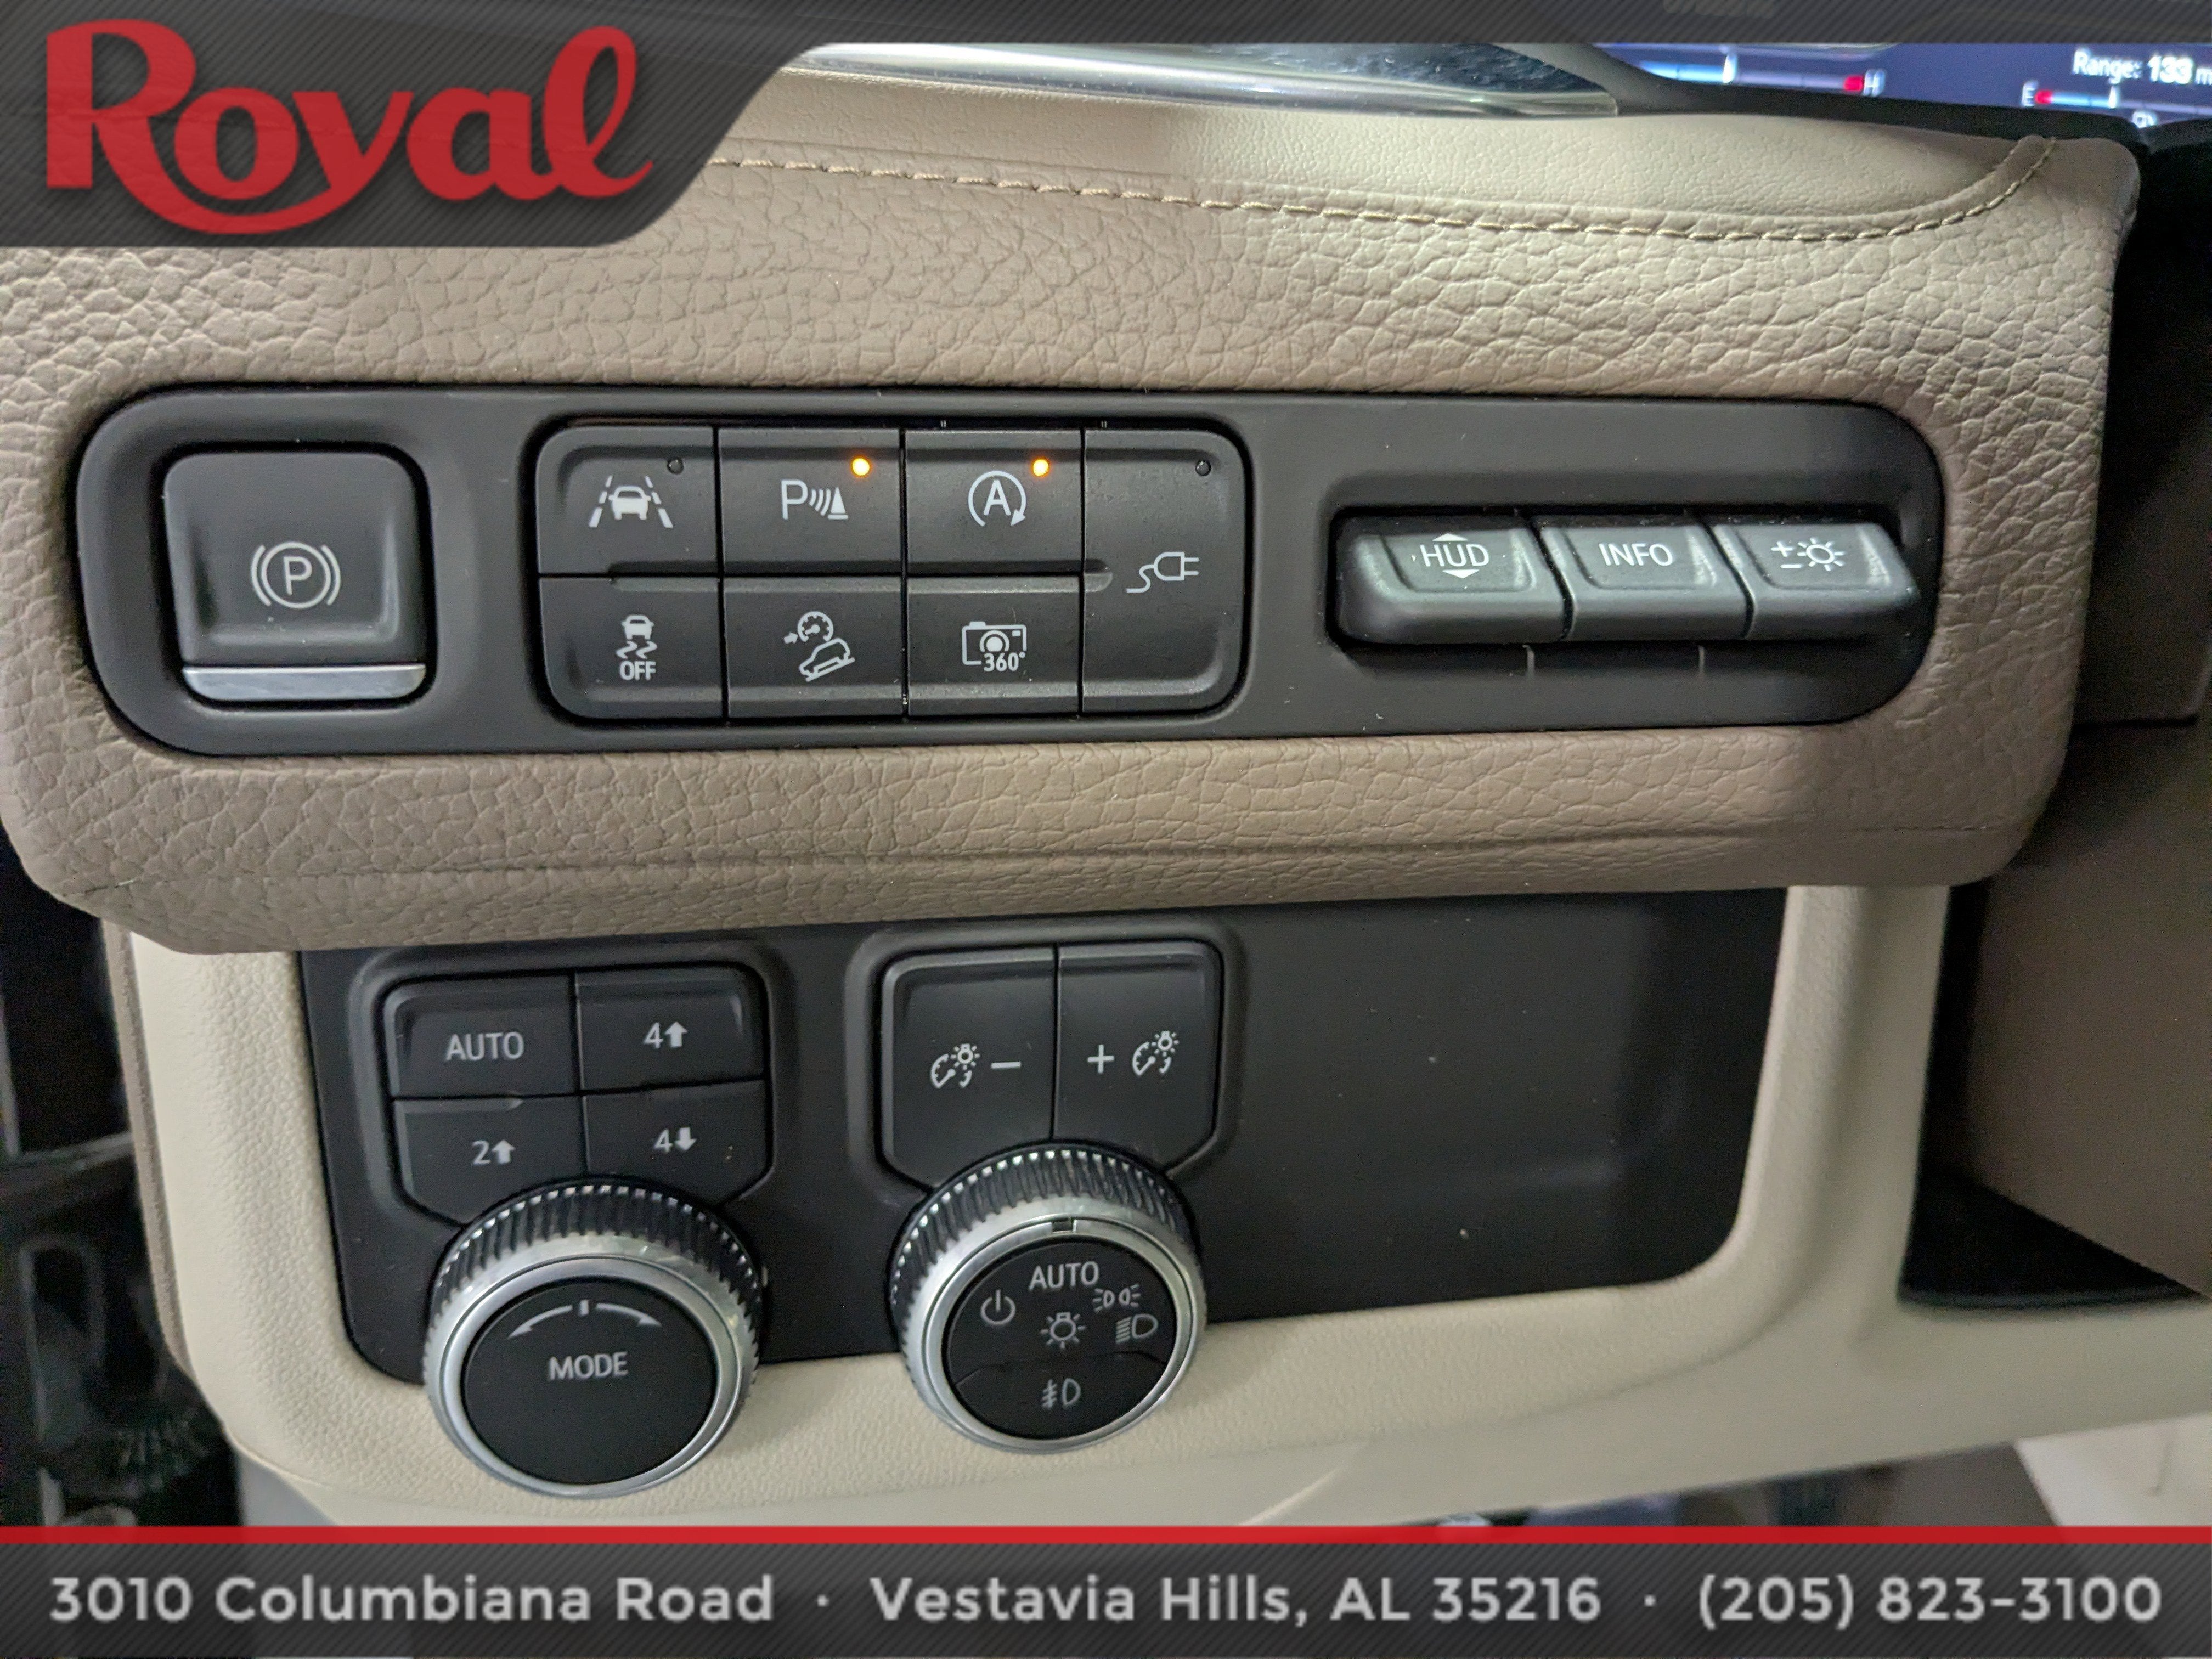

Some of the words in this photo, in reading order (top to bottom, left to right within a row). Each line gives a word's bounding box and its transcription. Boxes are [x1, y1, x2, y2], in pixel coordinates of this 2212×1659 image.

[2072, 48, 2142, 84] Range:
[2021, 81, 2037, 107] E
[1419, 543, 1490, 567] HUD
[1598, 542, 1673, 567] INFO
[619, 660, 657, 680] OFF
[445, 1031, 525, 1061] AUTO
[643, 1022, 663, 1049] 4
[471, 1140, 490, 1166] 2
[654, 1128, 673, 1153] 4
[1028, 1261, 1100, 1291] AUTO
[548, 1351, 629, 1381] MODE
